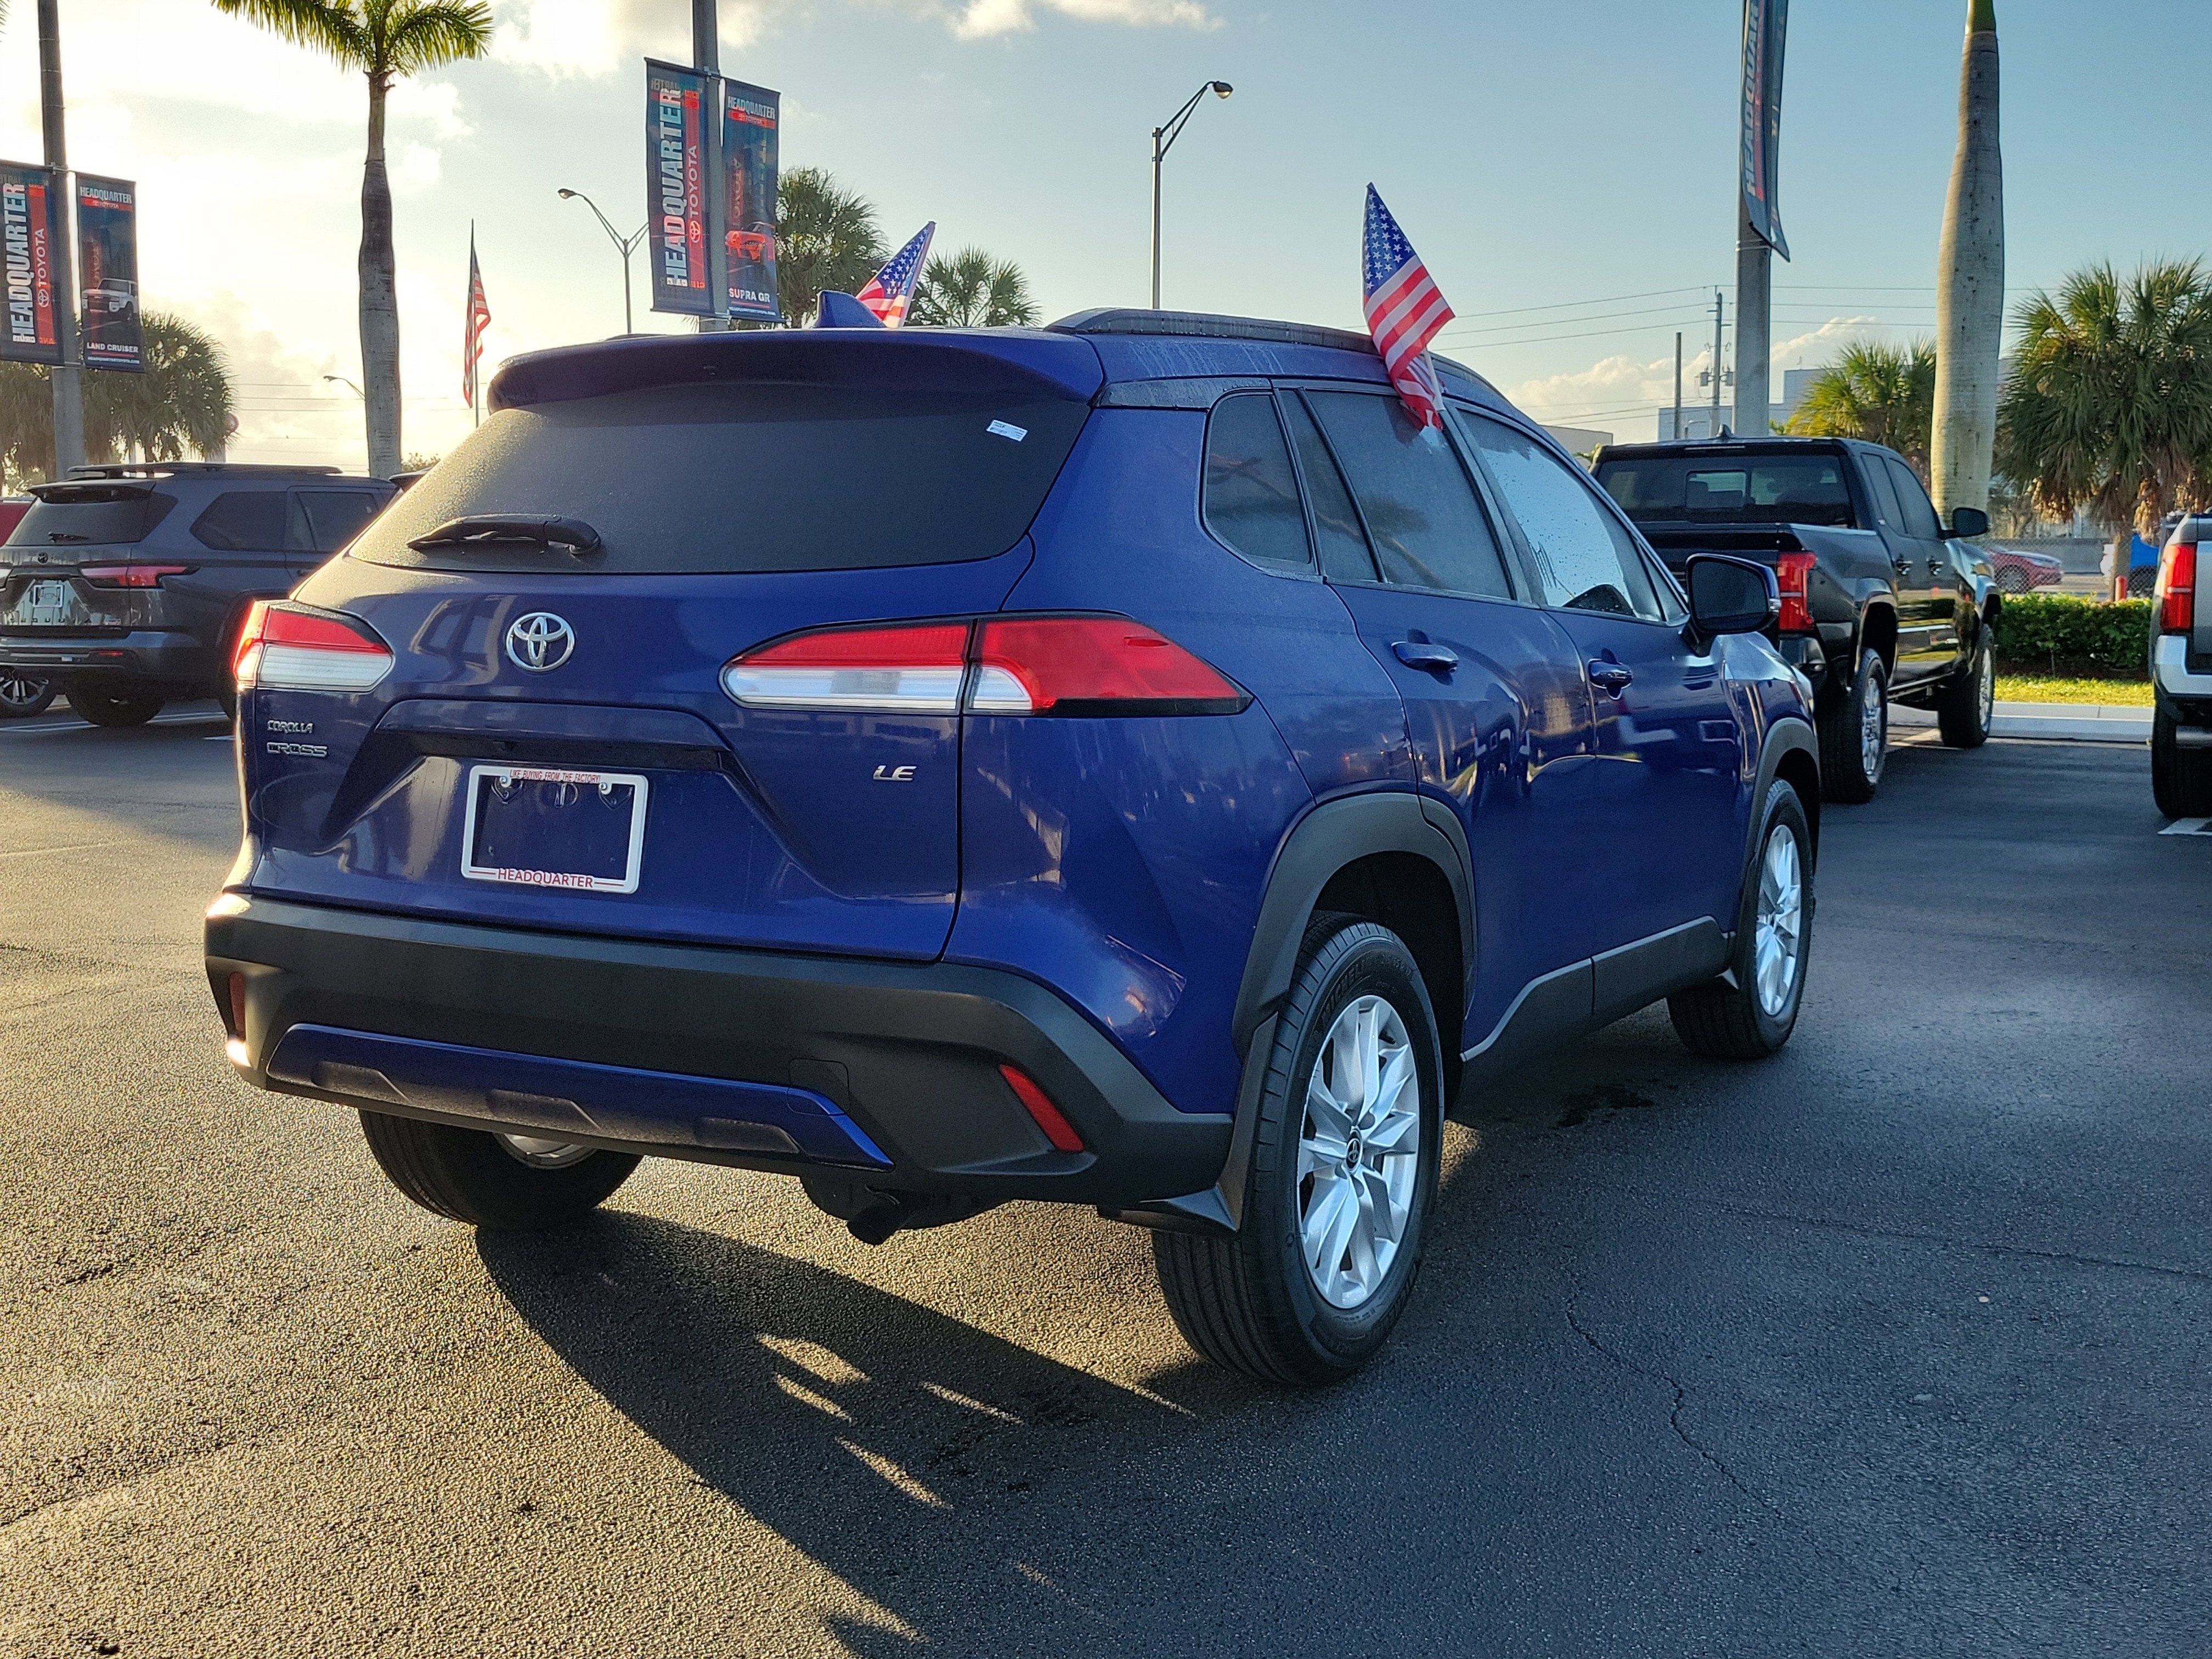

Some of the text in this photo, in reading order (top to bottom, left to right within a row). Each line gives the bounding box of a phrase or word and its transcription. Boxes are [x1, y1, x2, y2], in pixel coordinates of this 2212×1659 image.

[728, 96, 775, 120] HEADQUARTER
[659, 87, 688, 287] HEADQUARTER
[689, 145, 699, 218] TOYOTA
[80, 186, 132, 204] HEADQUARTER
[3, 183, 36, 343] HEADQUARTER
[34, 228, 47, 287] TOYOTA
[729, 287, 770, 303] SUPRA GR
[87, 342, 139, 353] LAND CRUISER
[267, 720, 314, 734] COROLLA
[267, 742, 328, 758] CROSS
[523, 770, 542, 780] BUYING
[545, 771, 560, 781] FROM
[563, 772, 572, 782] THE
[873, 765, 917, 781] LE
[498, 869, 593, 888] HEADQUARTER
